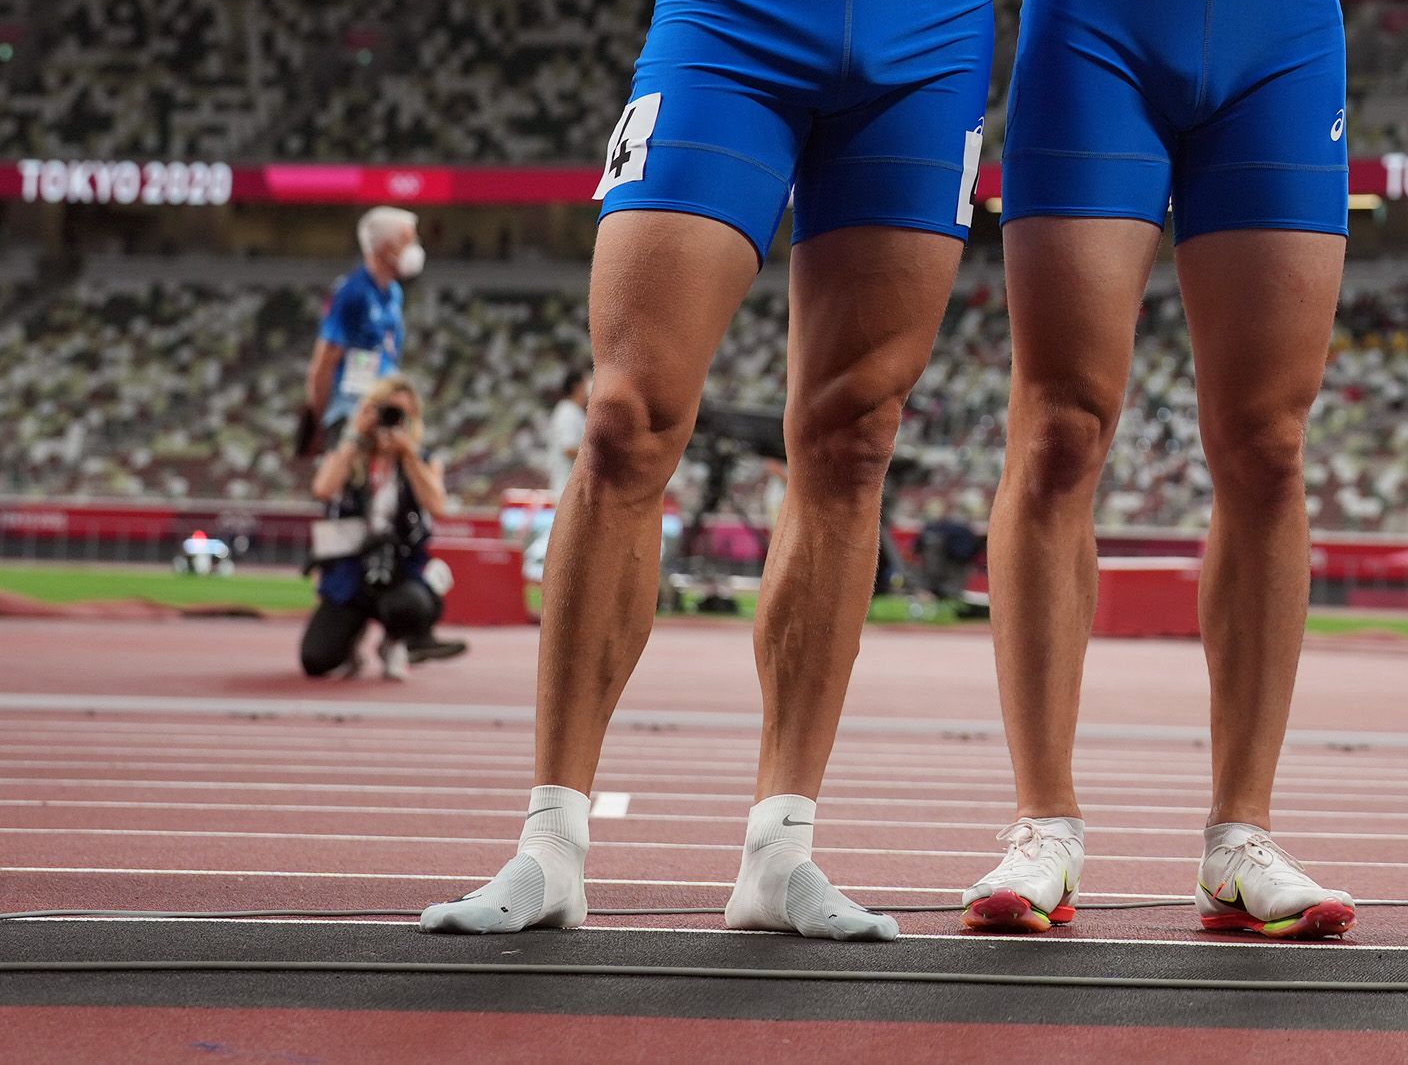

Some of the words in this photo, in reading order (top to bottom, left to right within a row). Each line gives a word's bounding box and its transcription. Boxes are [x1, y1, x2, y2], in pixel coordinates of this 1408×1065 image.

[608, 106, 636, 179] 4
[17, 159, 141, 204] TOKYO
[141, 160, 233, 206] 2020
